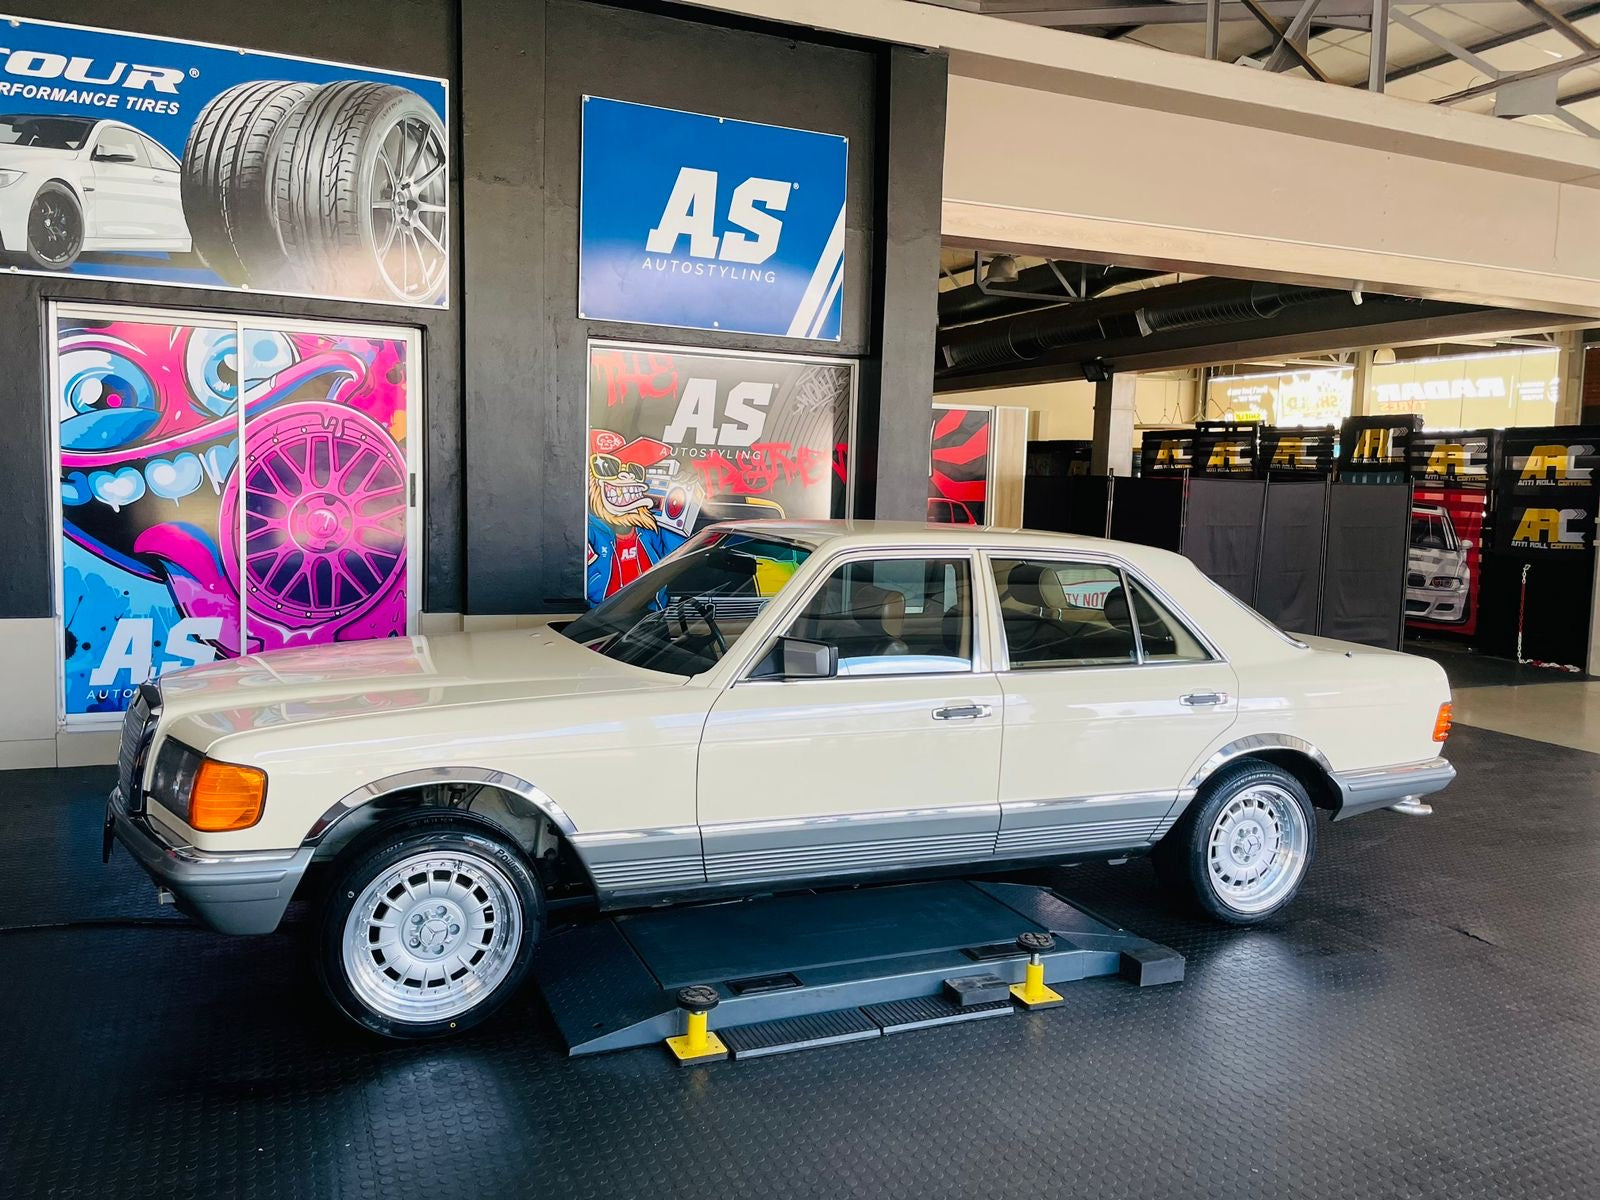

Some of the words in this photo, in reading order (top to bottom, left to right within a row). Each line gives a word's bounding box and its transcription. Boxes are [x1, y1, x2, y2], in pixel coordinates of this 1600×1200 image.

[0, 48, 185, 94] OUR
[126, 96, 180, 115] TIRES
[645, 166, 792, 264] AS
[641, 257, 776, 284] AUTOSTYLING
[662, 377, 774, 446] AS
[659, 446, 762, 460] AUTOSTYLING
[1426, 442, 1488, 476] ARC
[1520, 444, 1596, 480] ARC
[1517, 479, 1534, 487] ANTI
[1512, 507, 1588, 543] ARC
[621, 547, 638, 560] AS
[1529, 541, 1548, 549] ROLL
[1082, 591, 1107, 608] NOT
[89, 617, 223, 686] AS
